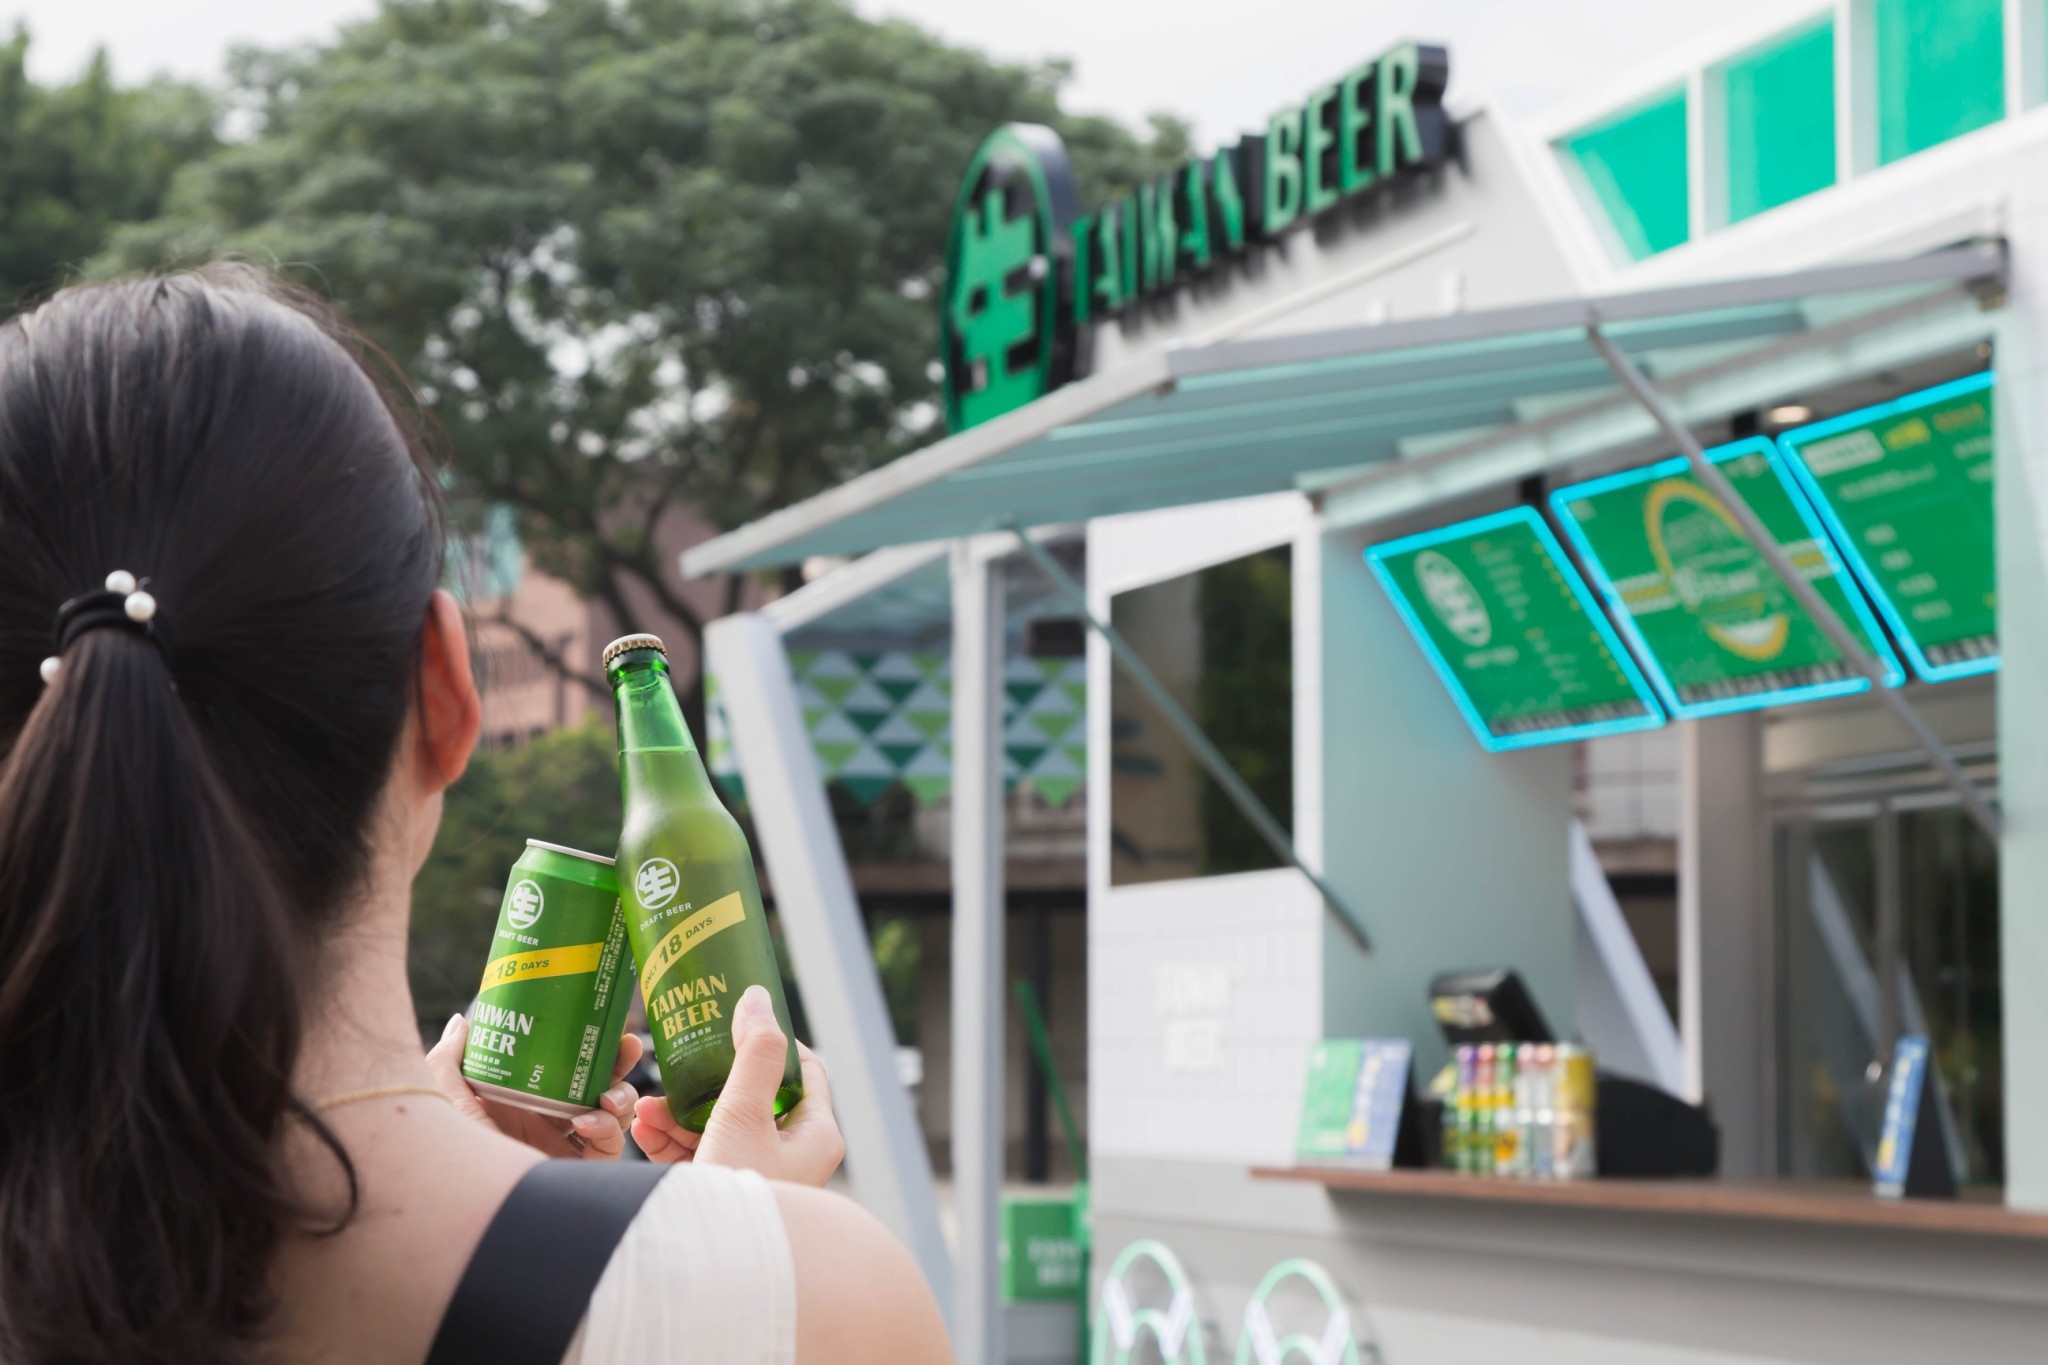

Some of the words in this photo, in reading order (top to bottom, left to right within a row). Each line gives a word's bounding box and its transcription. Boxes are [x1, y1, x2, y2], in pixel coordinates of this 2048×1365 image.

[1263, 41, 1426, 235] BEER
[638, 865, 676, 906] 生
[640, 912, 664, 931] DRAFT
[666, 902, 692, 917] BEER
[498, 928, 517, 941] DRAFT
[517, 934, 539, 946] BEER
[644, 962, 659, 990] ONLY
[659, 933, 683, 964] 18
[685, 916, 714, 939] DAYS
[496, 959, 517, 980] 18
[520, 959, 549, 971] DAYS
[650, 973, 727, 1021] TAIWAN
[474, 1001, 534, 1036] TAIWAN
[662, 999, 723, 1040] BEER
[470, 1025, 516, 1057] BEER
[529, 1069, 543, 1083] 5
